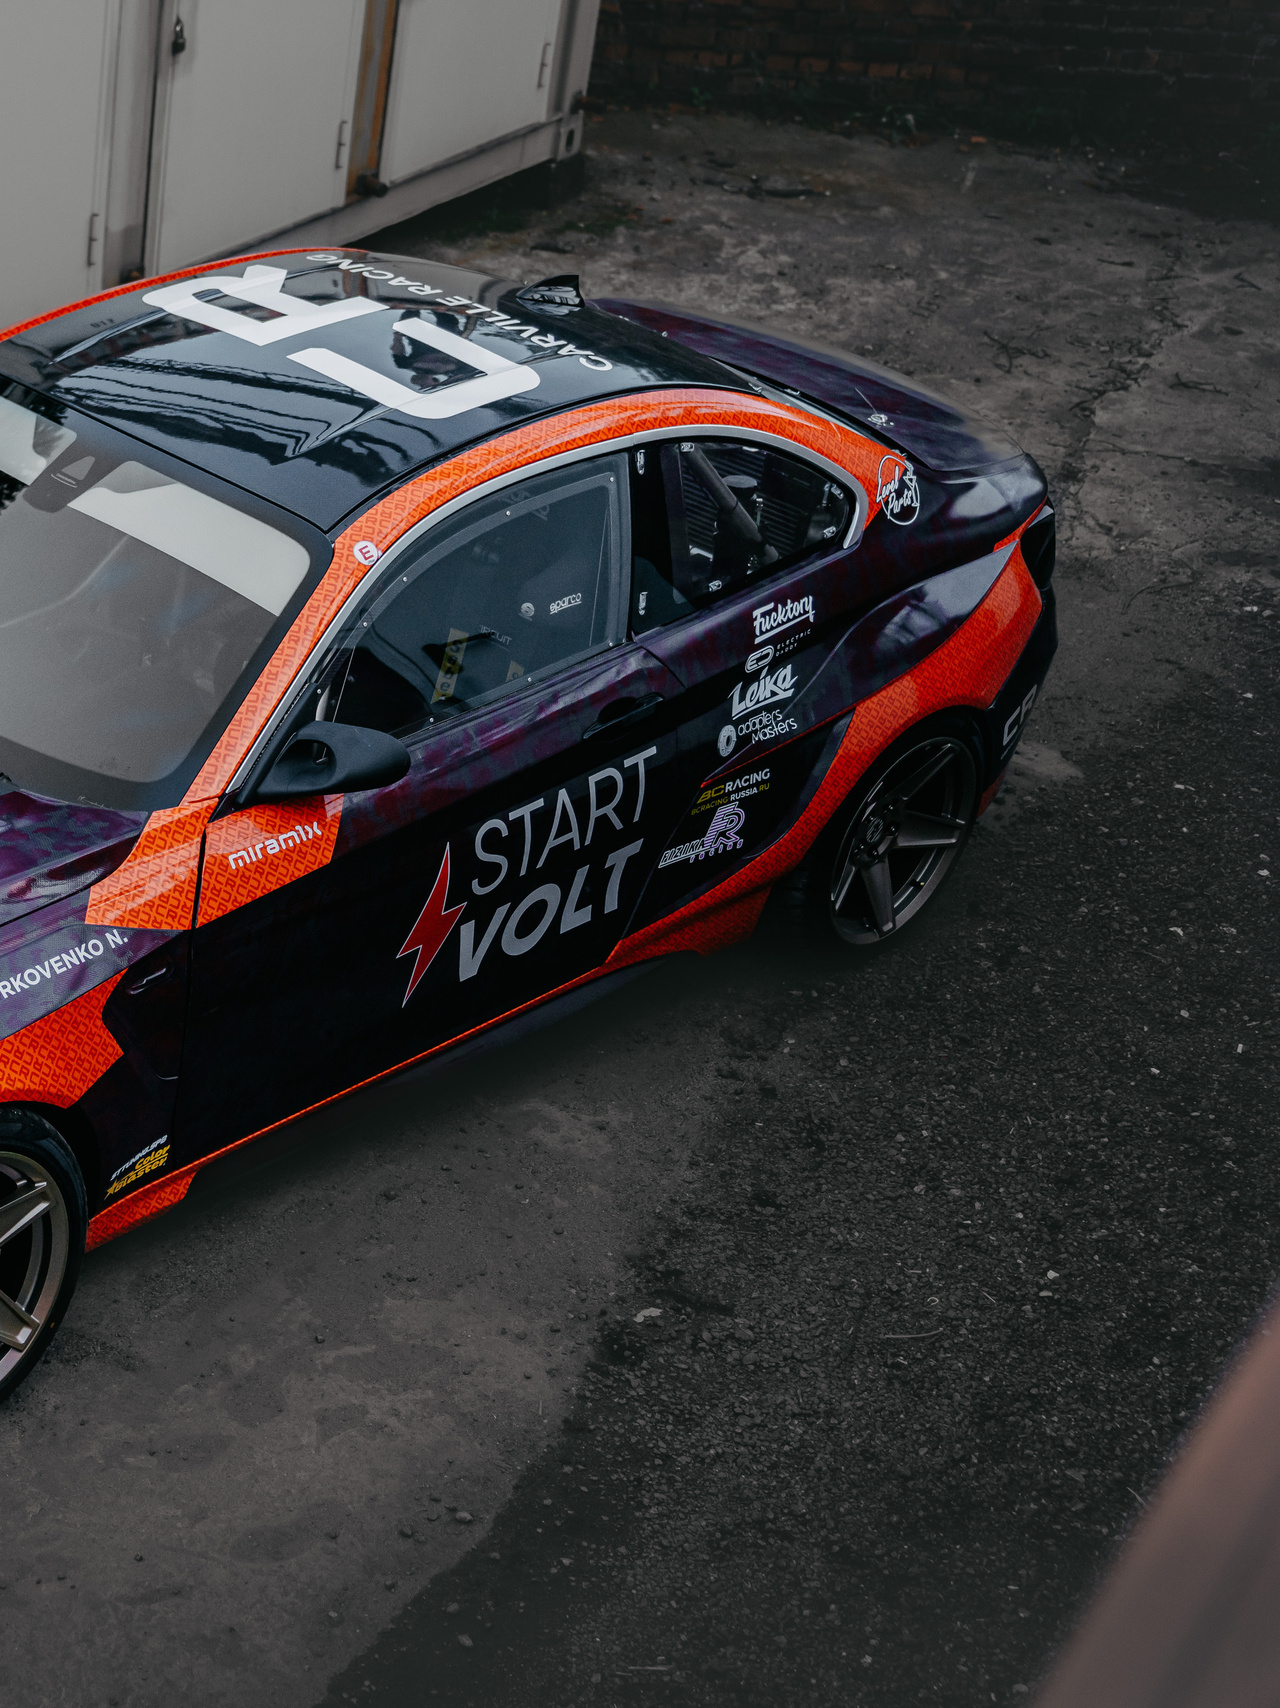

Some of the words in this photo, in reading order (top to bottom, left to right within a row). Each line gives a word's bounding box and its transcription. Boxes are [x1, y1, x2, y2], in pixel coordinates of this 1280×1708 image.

[306, 253, 447, 295] RACING
[435, 294, 614, 372] CARVILLE
[876, 465, 900, 503] Level
[888, 488, 912, 519] Parts
[358, 545, 375, 561] E
[549, 592, 583, 615] sparco
[752, 595, 816, 645] Fucktory
[775, 641, 800, 657] DADDY
[776, 628, 813, 650] ELECTRIC
[727, 663, 799, 720] Leika
[737, 709, 783, 736] adapters
[751, 717, 798, 745] Masters
[471, 745, 657, 896] START
[227, 821, 323, 870] miramix
[459, 838, 645, 982] VOLT
[104, 928, 130, 949] N.
[134, 1144, 171, 1170] Color
